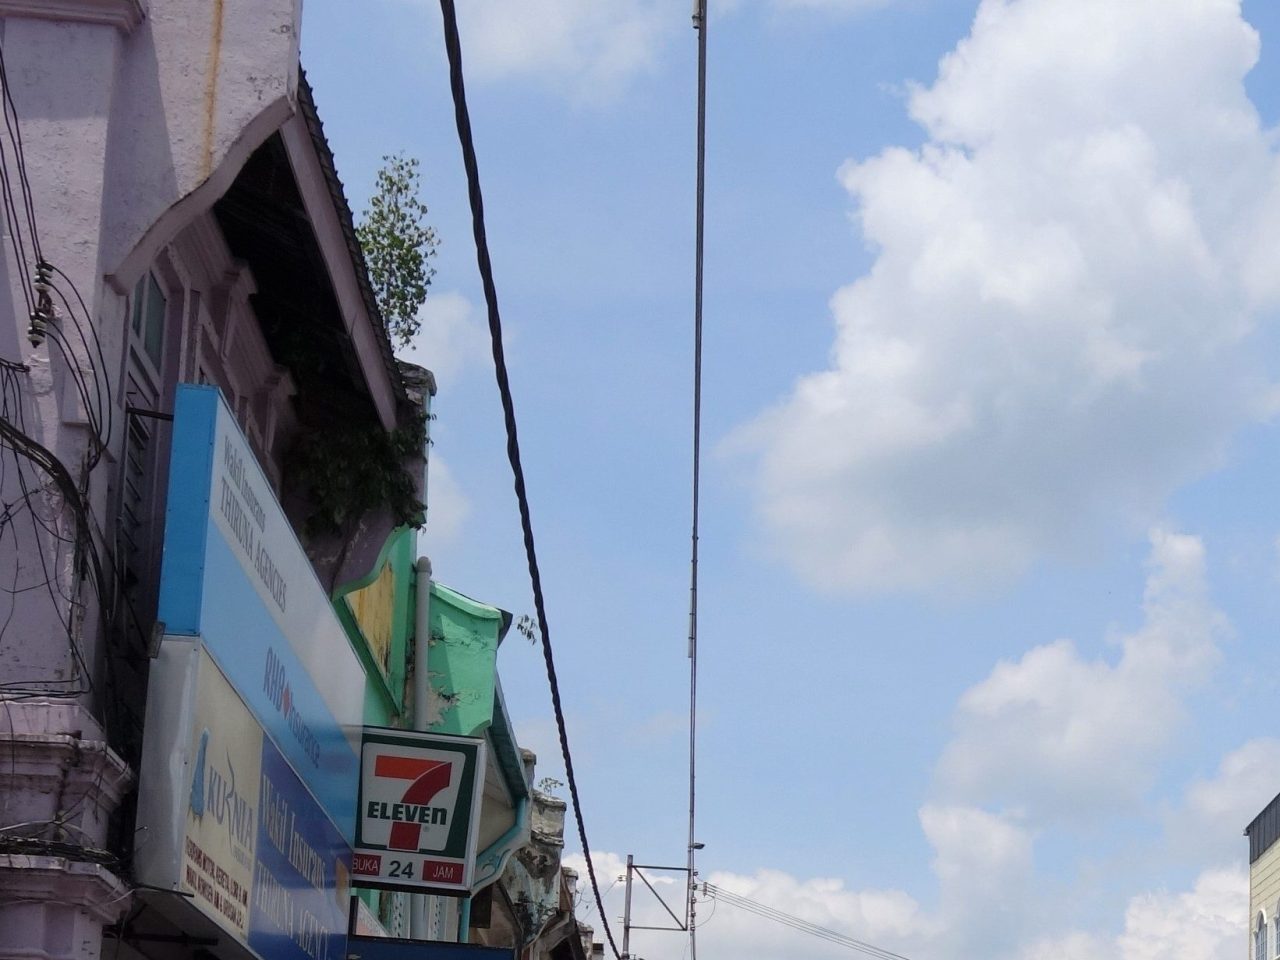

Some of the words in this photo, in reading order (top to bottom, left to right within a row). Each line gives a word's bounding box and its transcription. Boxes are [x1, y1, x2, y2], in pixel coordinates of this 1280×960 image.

[220, 476, 254, 561] THIRUNA
[254, 538, 287, 613] AGENCIES
[263, 646, 285, 712] RHB
[207, 747, 253, 854] KURNIA
[263, 773, 288, 855] Wakil
[288, 811, 326, 895] Insurans
[375, 755, 452, 852] 7
[352, 857, 379, 872] BUKA
[388, 860, 414, 879] 24
[433, 866, 454, 878] JAM
